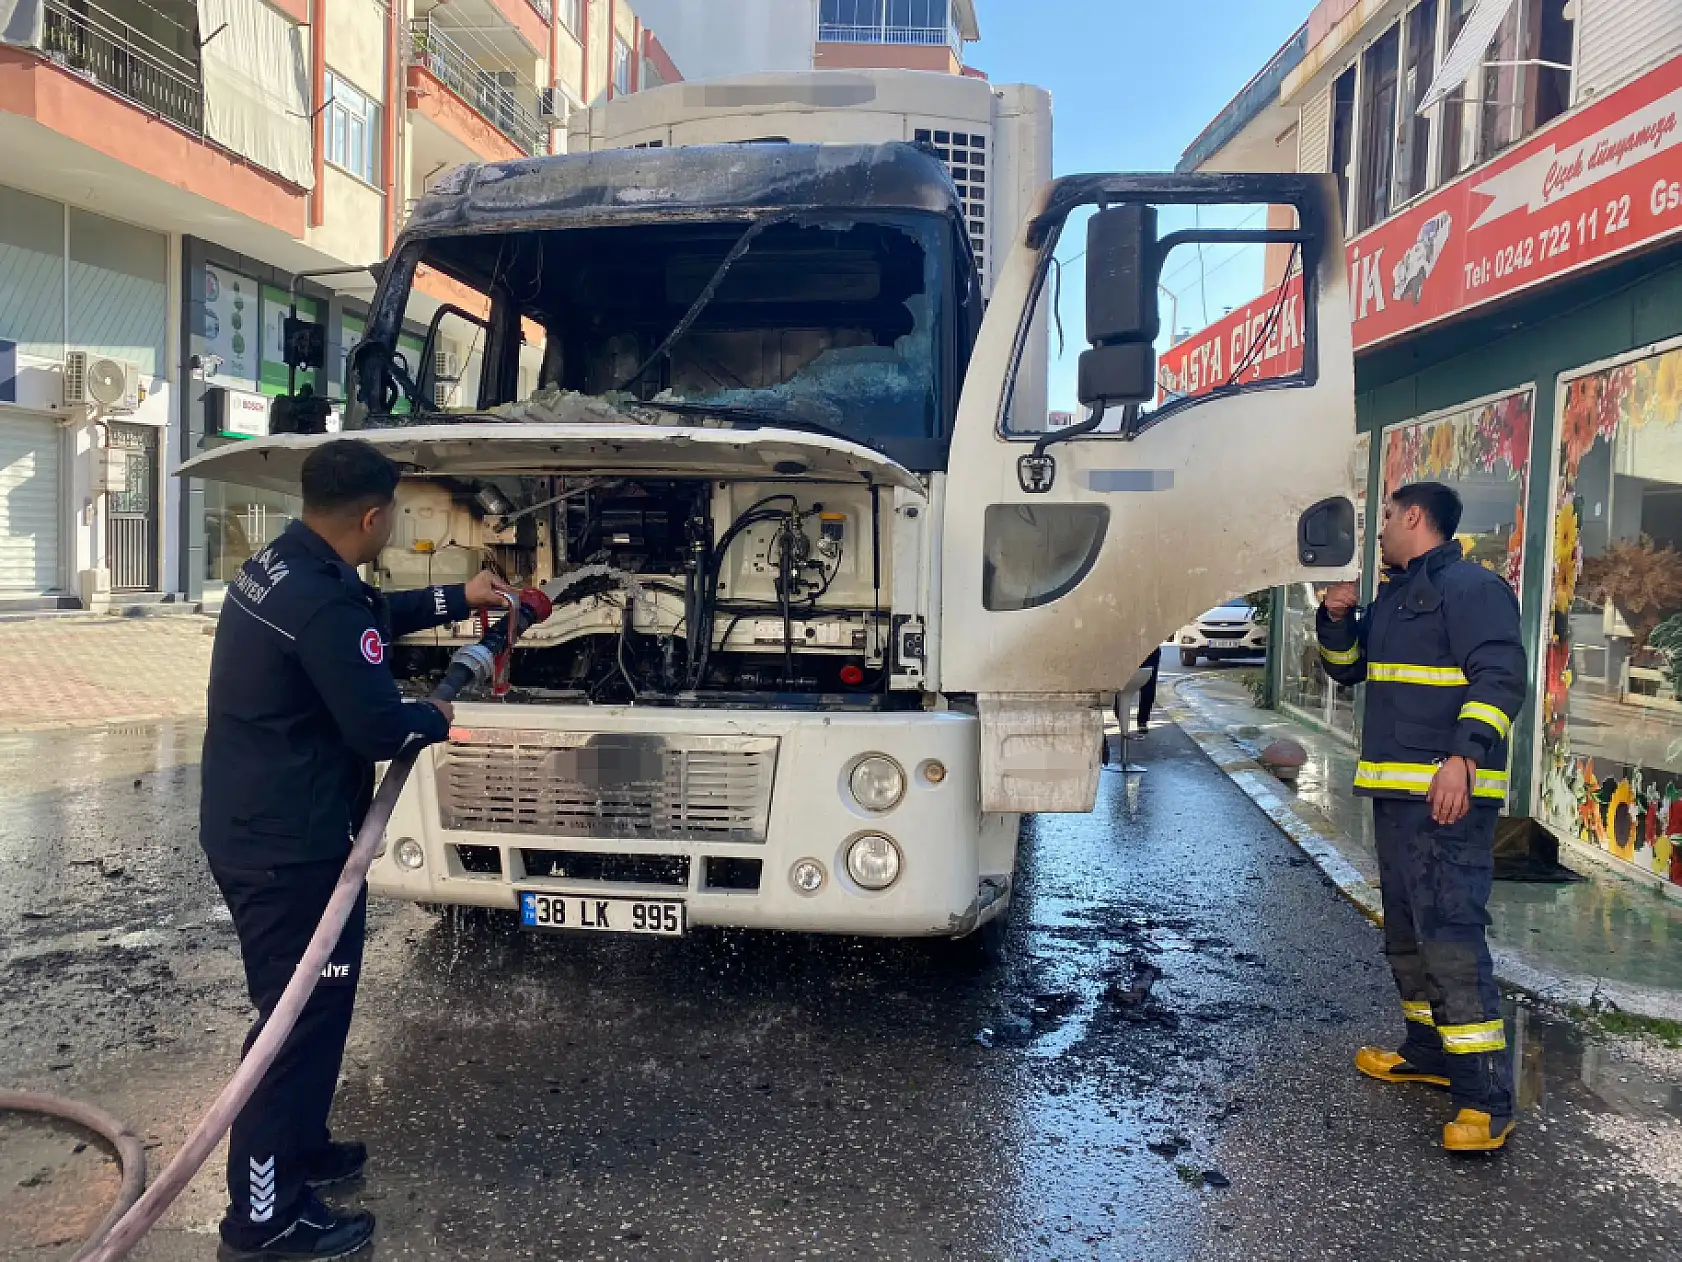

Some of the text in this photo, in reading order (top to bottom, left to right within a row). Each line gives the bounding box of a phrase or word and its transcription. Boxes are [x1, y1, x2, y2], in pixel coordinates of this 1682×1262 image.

[1464, 179, 1682, 289] Tel: 0242 722 11 22 Gs
[1180, 336, 1223, 392] ASYA
[1230, 293, 1305, 386] ÇİÇEK
[537, 897, 566, 924] 38
[581, 899, 610, 928] LK
[632, 903, 678, 932] 995
